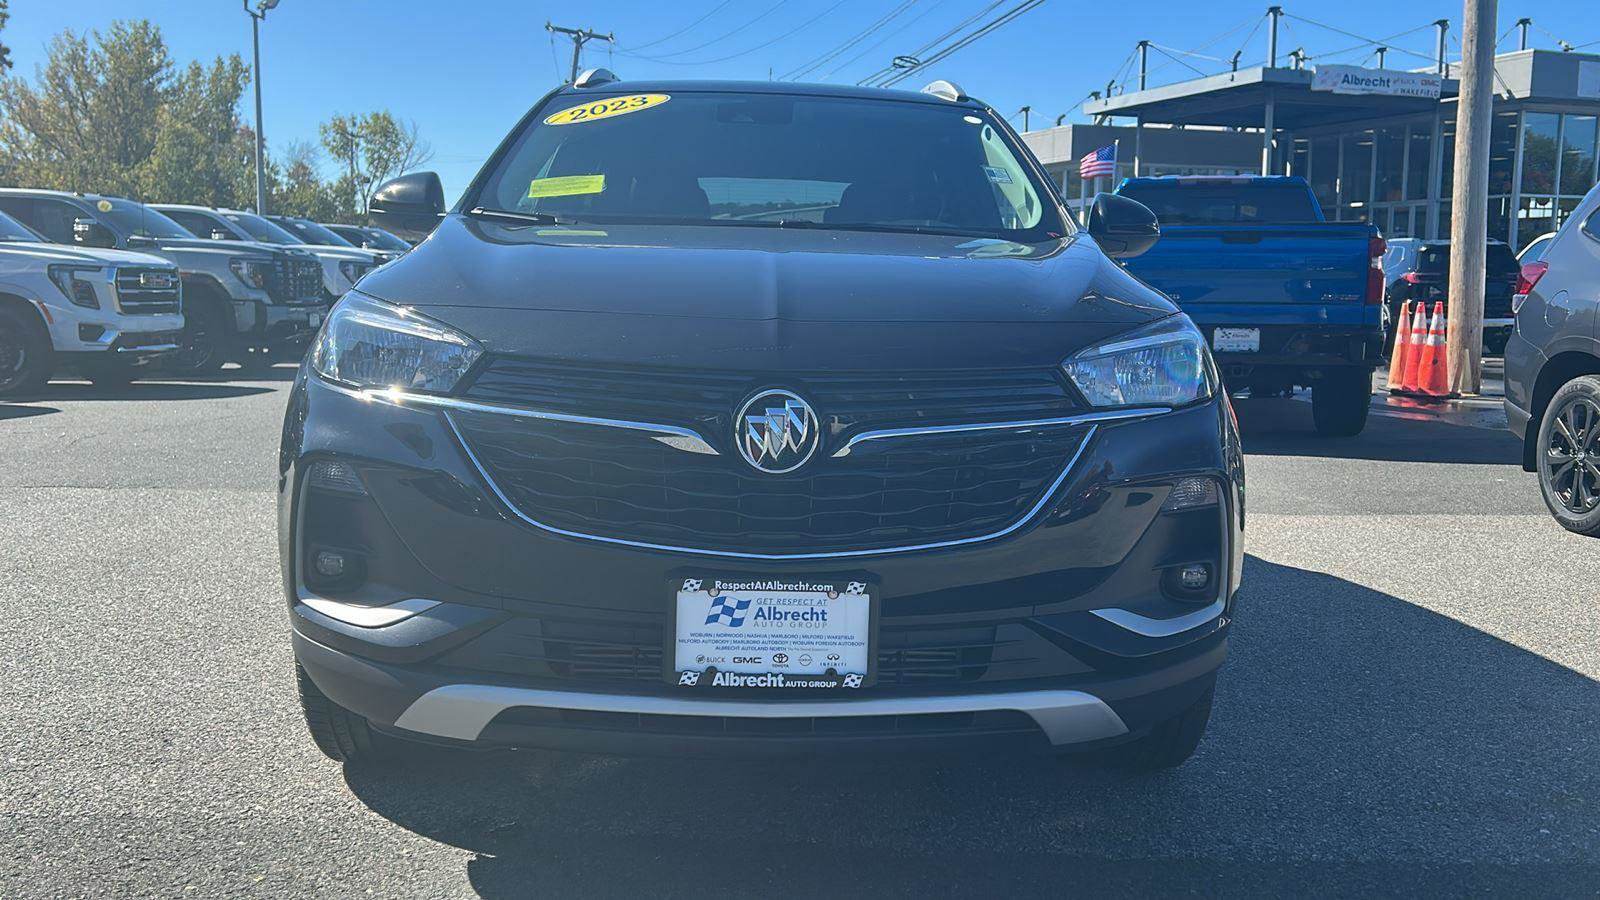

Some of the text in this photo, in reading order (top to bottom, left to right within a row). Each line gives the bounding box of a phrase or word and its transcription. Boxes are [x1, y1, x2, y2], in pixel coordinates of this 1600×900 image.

[1341, 73, 1390, 88] Albrecht
[1420, 79, 1439, 87] GMC
[1400, 88, 1439, 98] WAKEFIELD
[570, 96, 649, 121] 2023
[715, 580, 834, 592] RespectAtAlbrecht.com
[753, 606, 828, 622] Albrecht
[712, 672, 784, 688] Albrecht
[808, 680, 837, 688] GROUP
